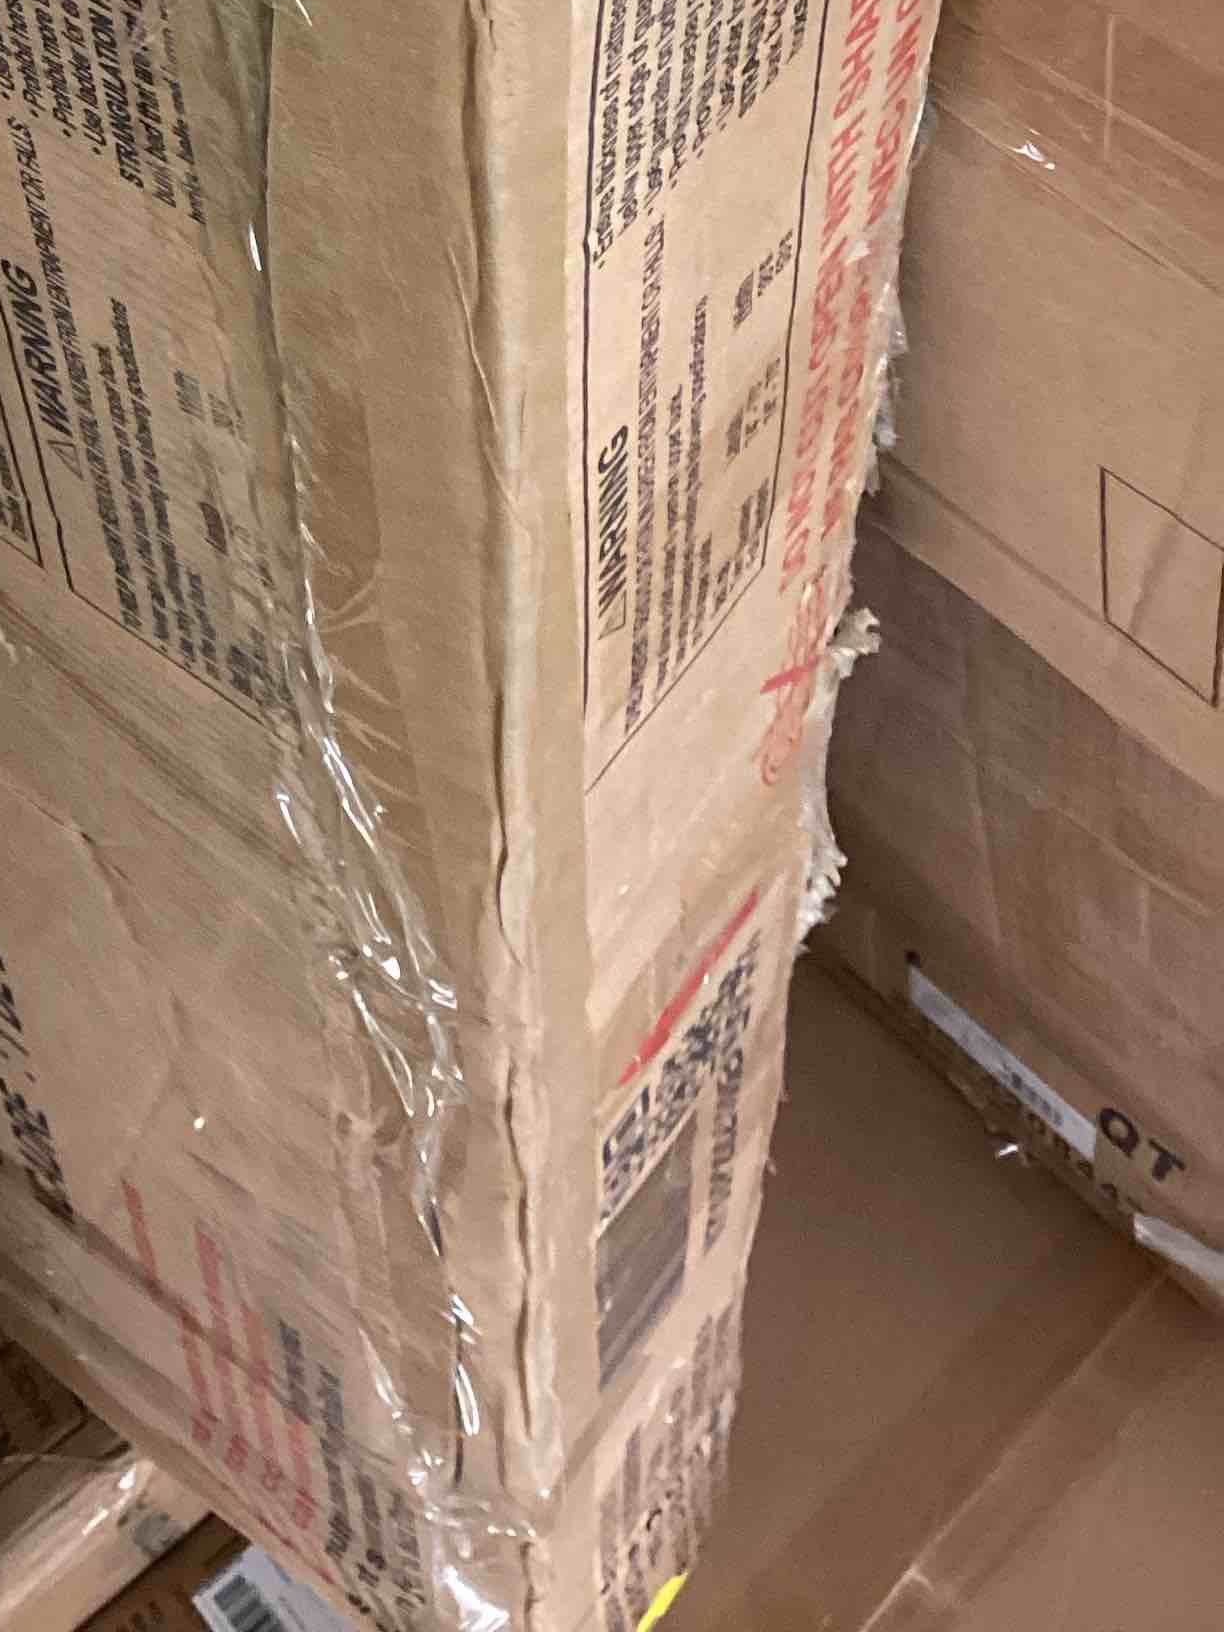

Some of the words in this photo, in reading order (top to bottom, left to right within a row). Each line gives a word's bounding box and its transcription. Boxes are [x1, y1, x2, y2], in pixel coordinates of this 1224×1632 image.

[35, 6, 62, 60] more
[59, 13, 87, 50] for
[11, 36, 47, 113] Prohibit
[41, 53, 77, 132] Prohibit
[65, 43, 100, 112] ladder
[87, 5, 145, 192] STRANGULATION
[132, 79, 161, 126] that
[78, 103, 108, 150] Use
[139, 118, 168, 164] bed
[819, 104, 865, 253] WITH
[596, 419, 628, 620] WARNING
